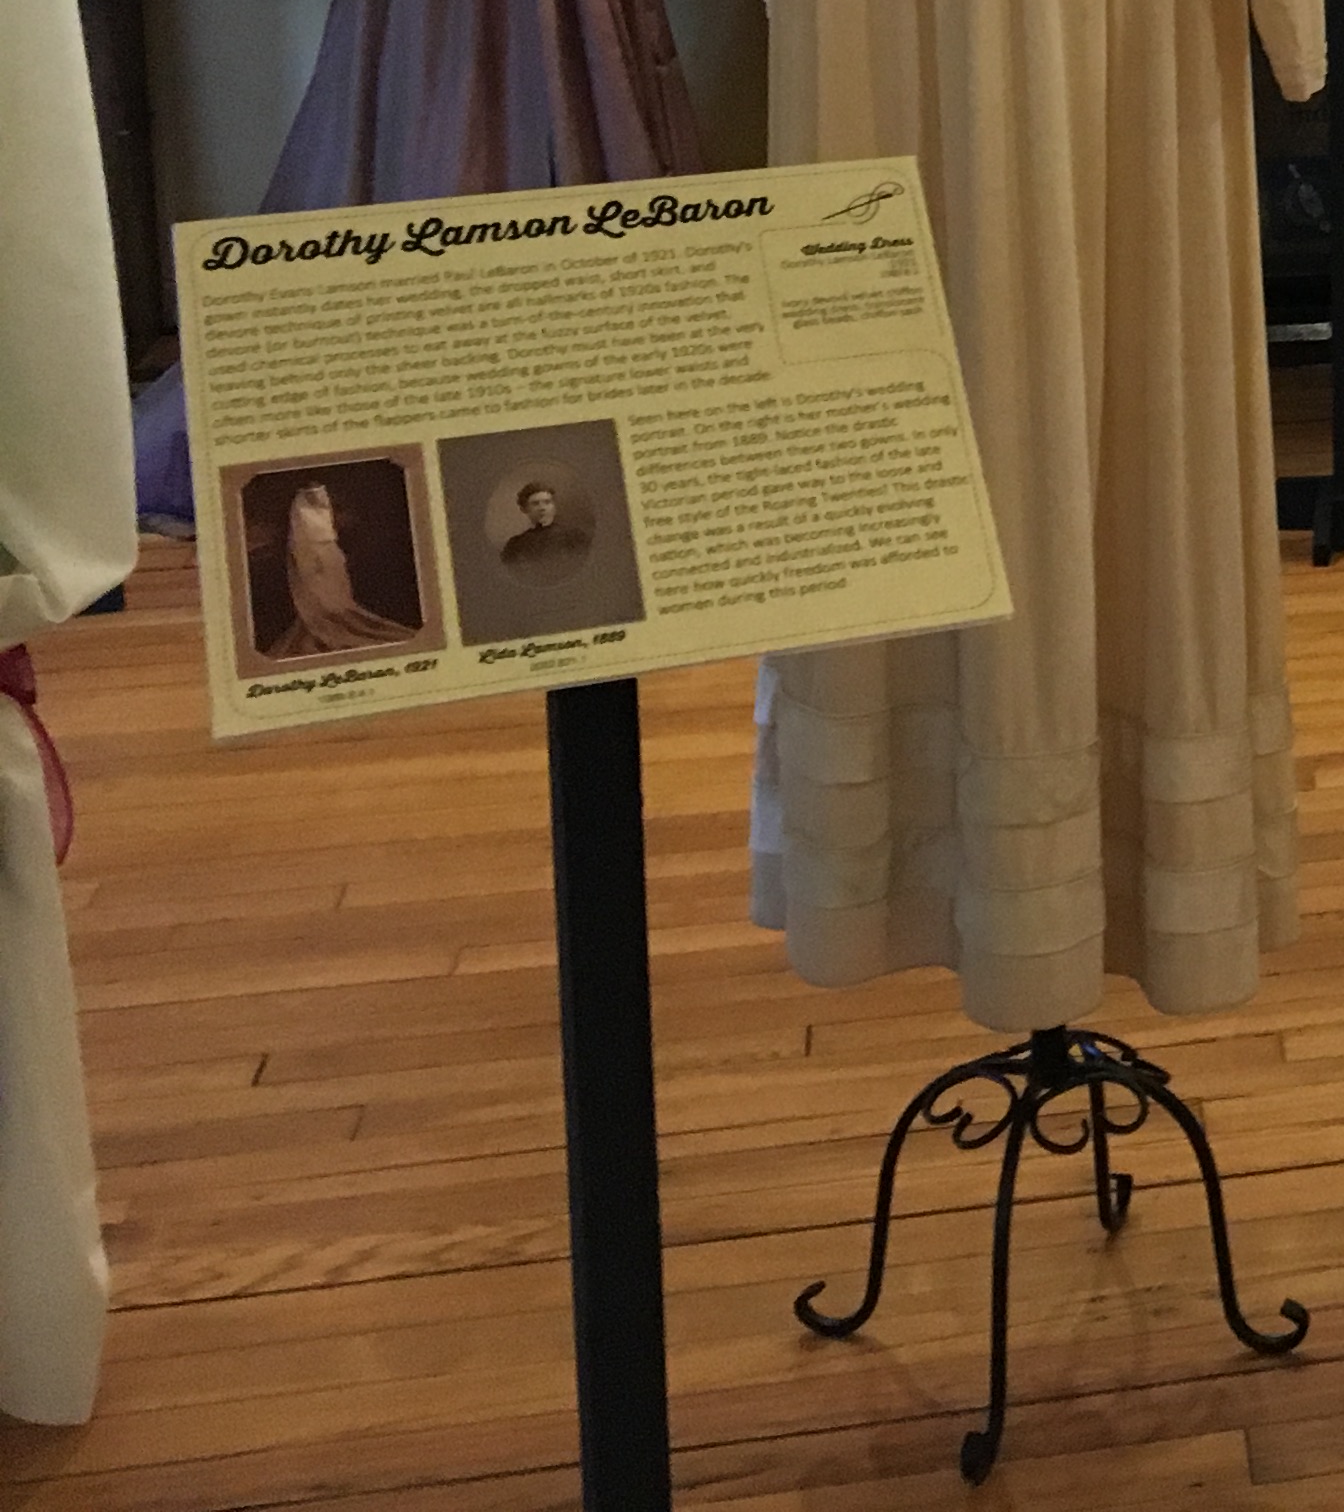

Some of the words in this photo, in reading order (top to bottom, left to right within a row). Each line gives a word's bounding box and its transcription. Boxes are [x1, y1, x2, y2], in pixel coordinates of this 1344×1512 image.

[202, 229, 396, 271] Dorothy
[400, 215, 578, 257] Lamson
[582, 195, 775, 239] LeBaron
[800, 241, 868, 256] Wedding
[869, 236, 914, 250] Dress
[519, 639, 589, 659] Lamson,
[592, 629, 627, 645] 1889
[245, 679, 317, 699] Dorothy
[319, 667, 401, 689] LeBaron,
